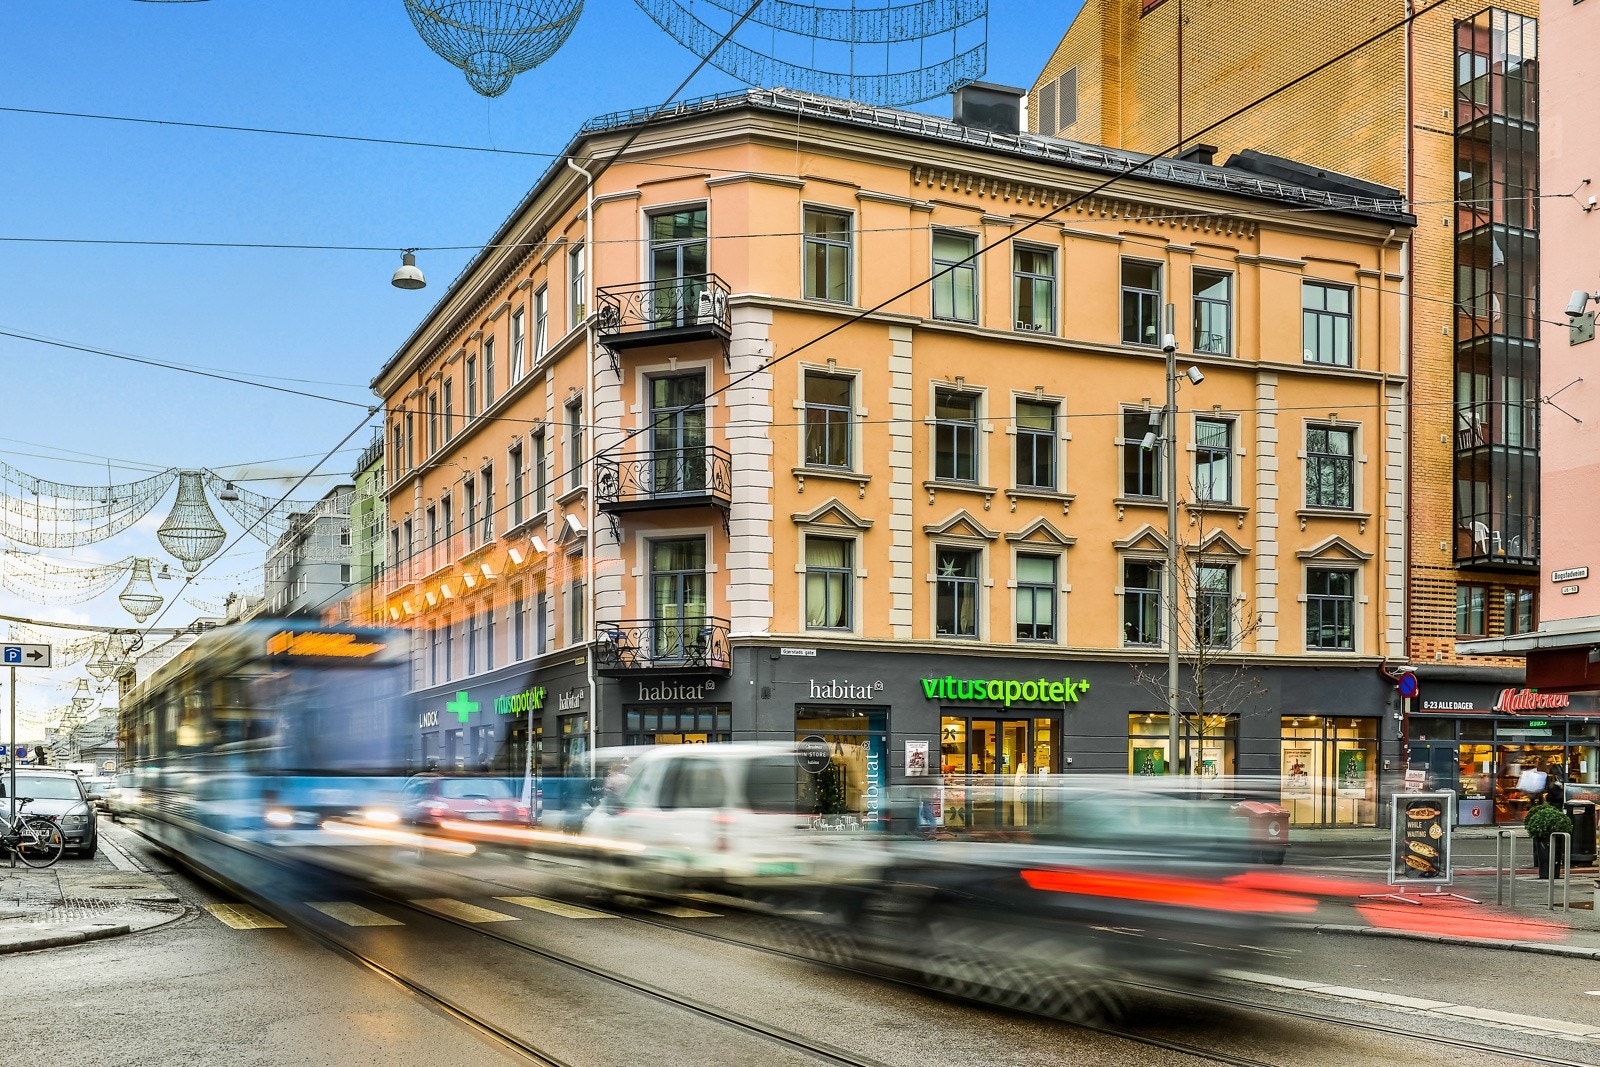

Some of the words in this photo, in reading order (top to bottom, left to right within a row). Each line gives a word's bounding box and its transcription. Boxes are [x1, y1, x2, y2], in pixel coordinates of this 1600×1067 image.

[1554, 569, 1585, 580] Bogstadveien
[638, 680, 705, 701] habitat
[809, 679, 874, 700] habitat
[559, 692, 581, 711] habitat
[1423, 701, 1438, 709] 8-23
[1438, 702, 1454, 710] ALLE
[1454, 702, 1474, 710] DAGER
[1493, 688, 1570, 715] Matkroken
[861, 752, 879, 823] habitat
[1407, 821, 1423, 829] WHILE
